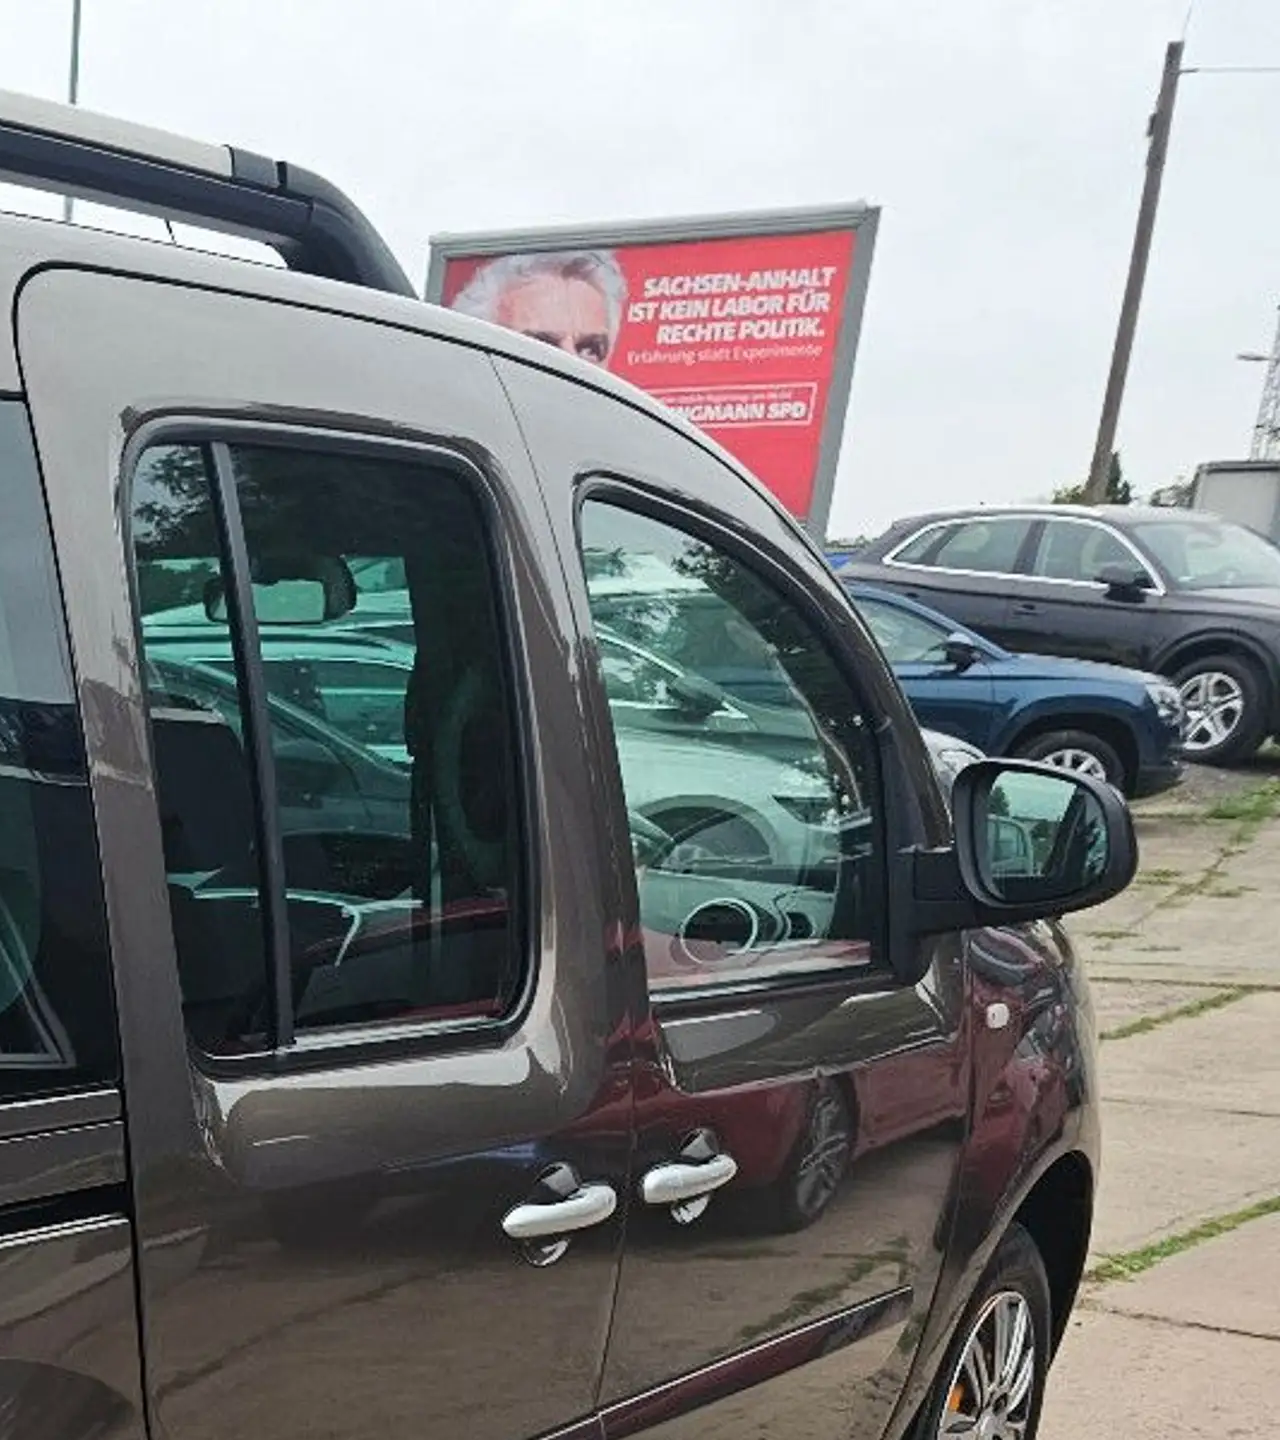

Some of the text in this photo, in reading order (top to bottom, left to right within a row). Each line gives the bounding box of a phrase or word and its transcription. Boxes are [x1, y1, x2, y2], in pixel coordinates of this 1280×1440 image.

[643, 266, 837, 299] SACHSEN-ANHALT
[627, 288, 831, 322] IST KEIN LABOR FÜR
[656, 316, 826, 345] RECHTE POLITIK.
[627, 349, 696, 367] Erfahrung
[767, 402, 806, 420] SPD
